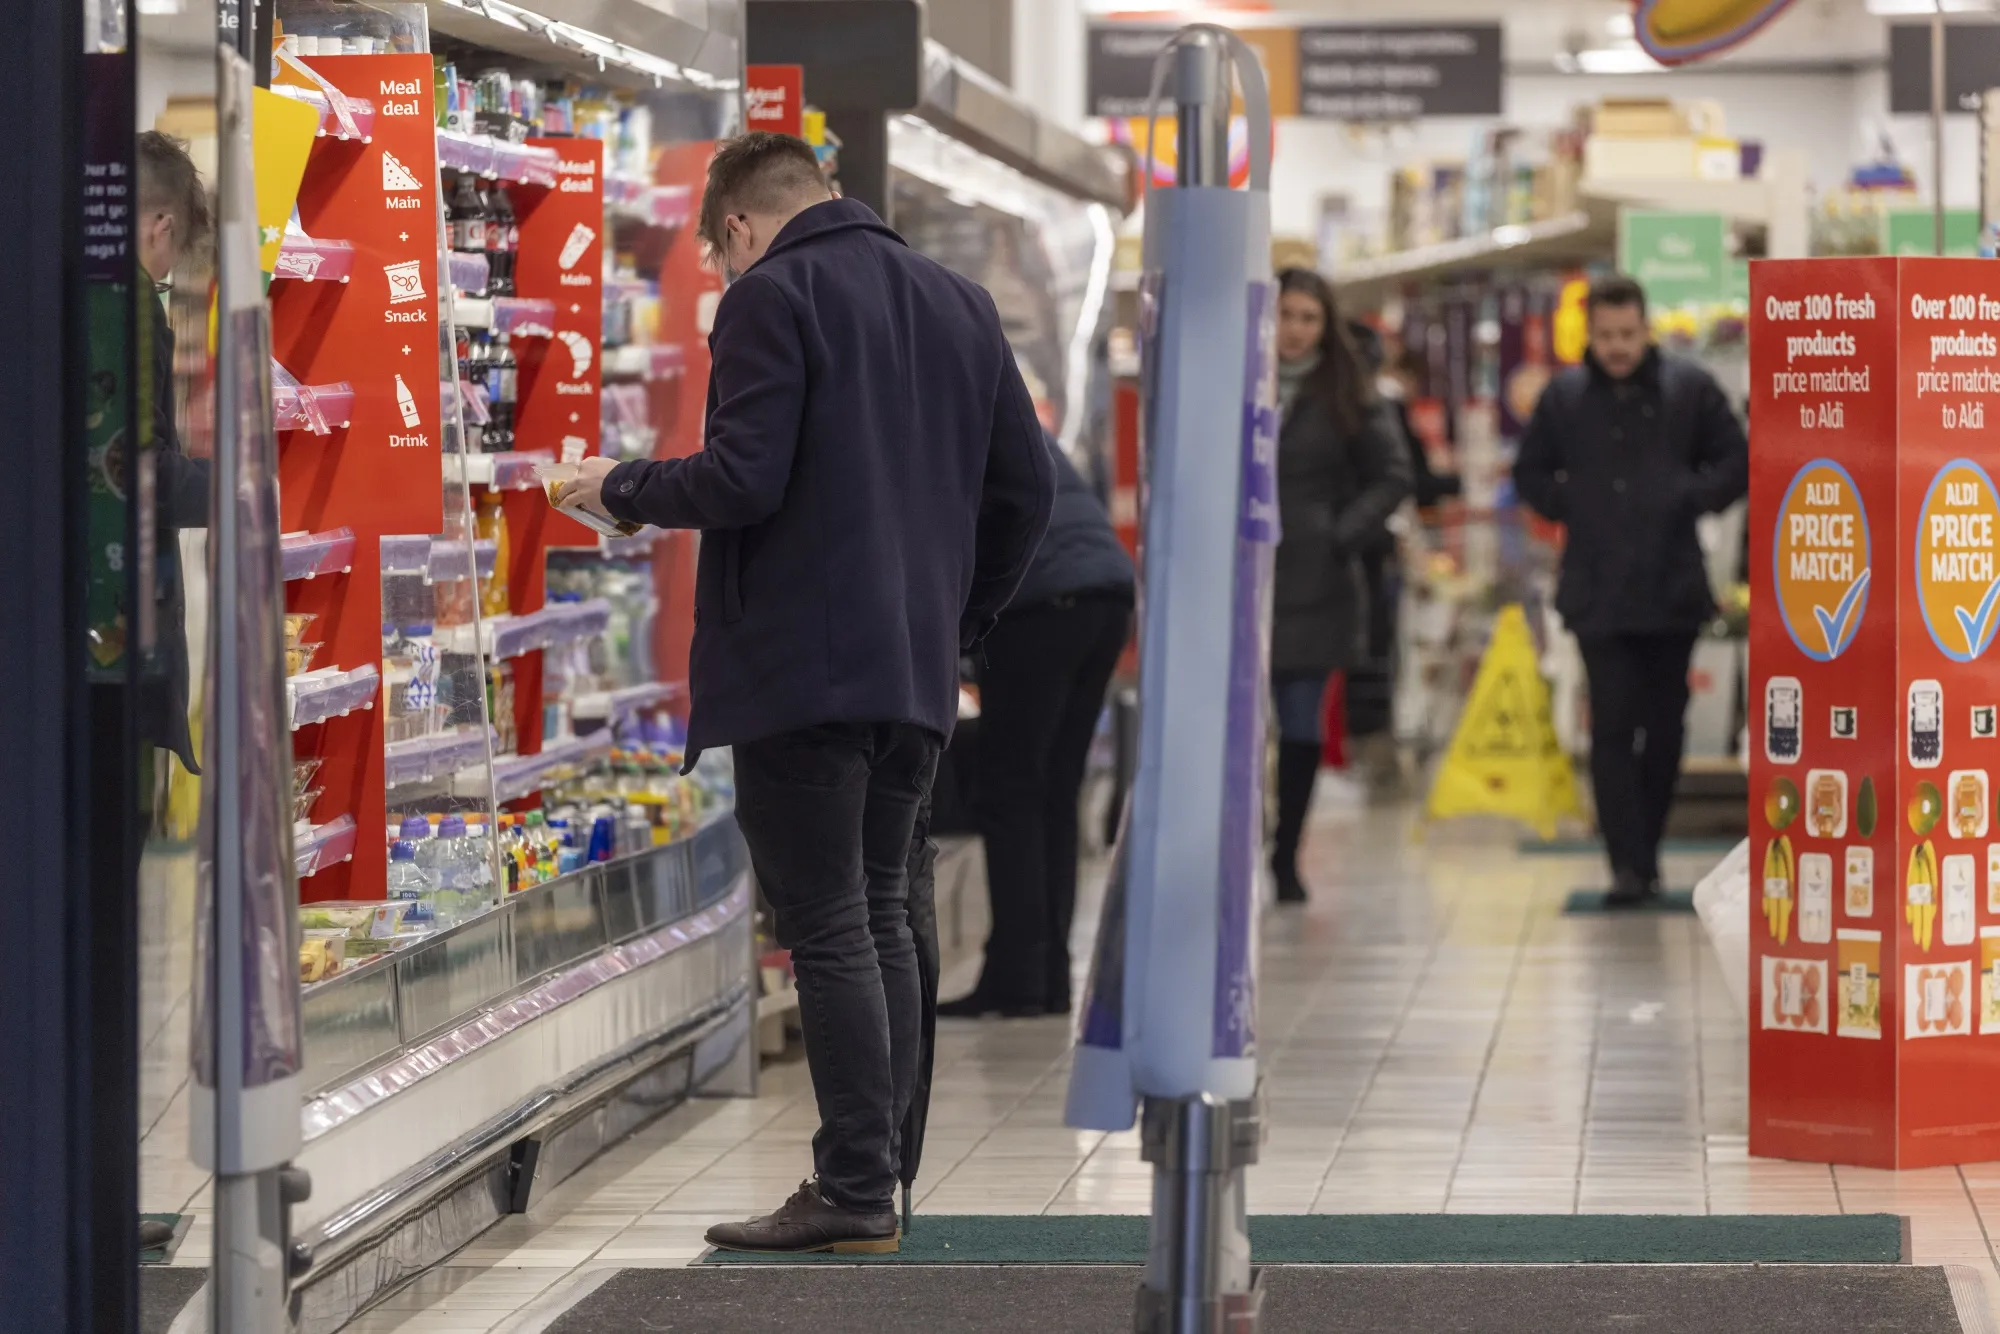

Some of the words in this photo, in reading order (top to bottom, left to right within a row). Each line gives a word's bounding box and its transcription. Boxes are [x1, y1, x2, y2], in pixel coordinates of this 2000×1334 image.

[380, 79, 421, 95] Meal
[382, 100, 420, 116] deal
[558, 160, 595, 174] Meal
[560, 177, 593, 192] deal
[385, 196, 421, 209] Main
[560, 273, 592, 286] Main
[384, 309, 427, 323] Snack
[1766, 295, 1801, 321] Over
[1804, 294, 1832, 320] 100
[1835, 292, 1875, 320] fresh
[1911, 293, 1946, 320] Over
[1949, 294, 1976, 320] 100
[1978, 293, 2000, 321] fre
[1786, 329, 1856, 363] products
[1930, 329, 1997, 363] products
[556, 381, 593, 394] Snack
[1773, 366, 1807, 399] price
[1810, 365, 1870, 392] matched
[1917, 366, 1949, 399] price
[1952, 366, 2000, 393] matche
[1800, 404, 1815, 428] to
[1818, 401, 1844, 428] Aldi
[1942, 404, 1956, 429] to
[1959, 401, 1984, 429] Aldi
[389, 434, 428, 447] Drink
[1805, 482, 1840, 506] ALDI
[1945, 482, 1979, 506] ALDI
[1789, 513, 1854, 548] PRICE
[1930, 513, 1993, 548] PRICE
[1790, 552, 1853, 582] MATCH
[1931, 552, 1993, 583] MATCH
